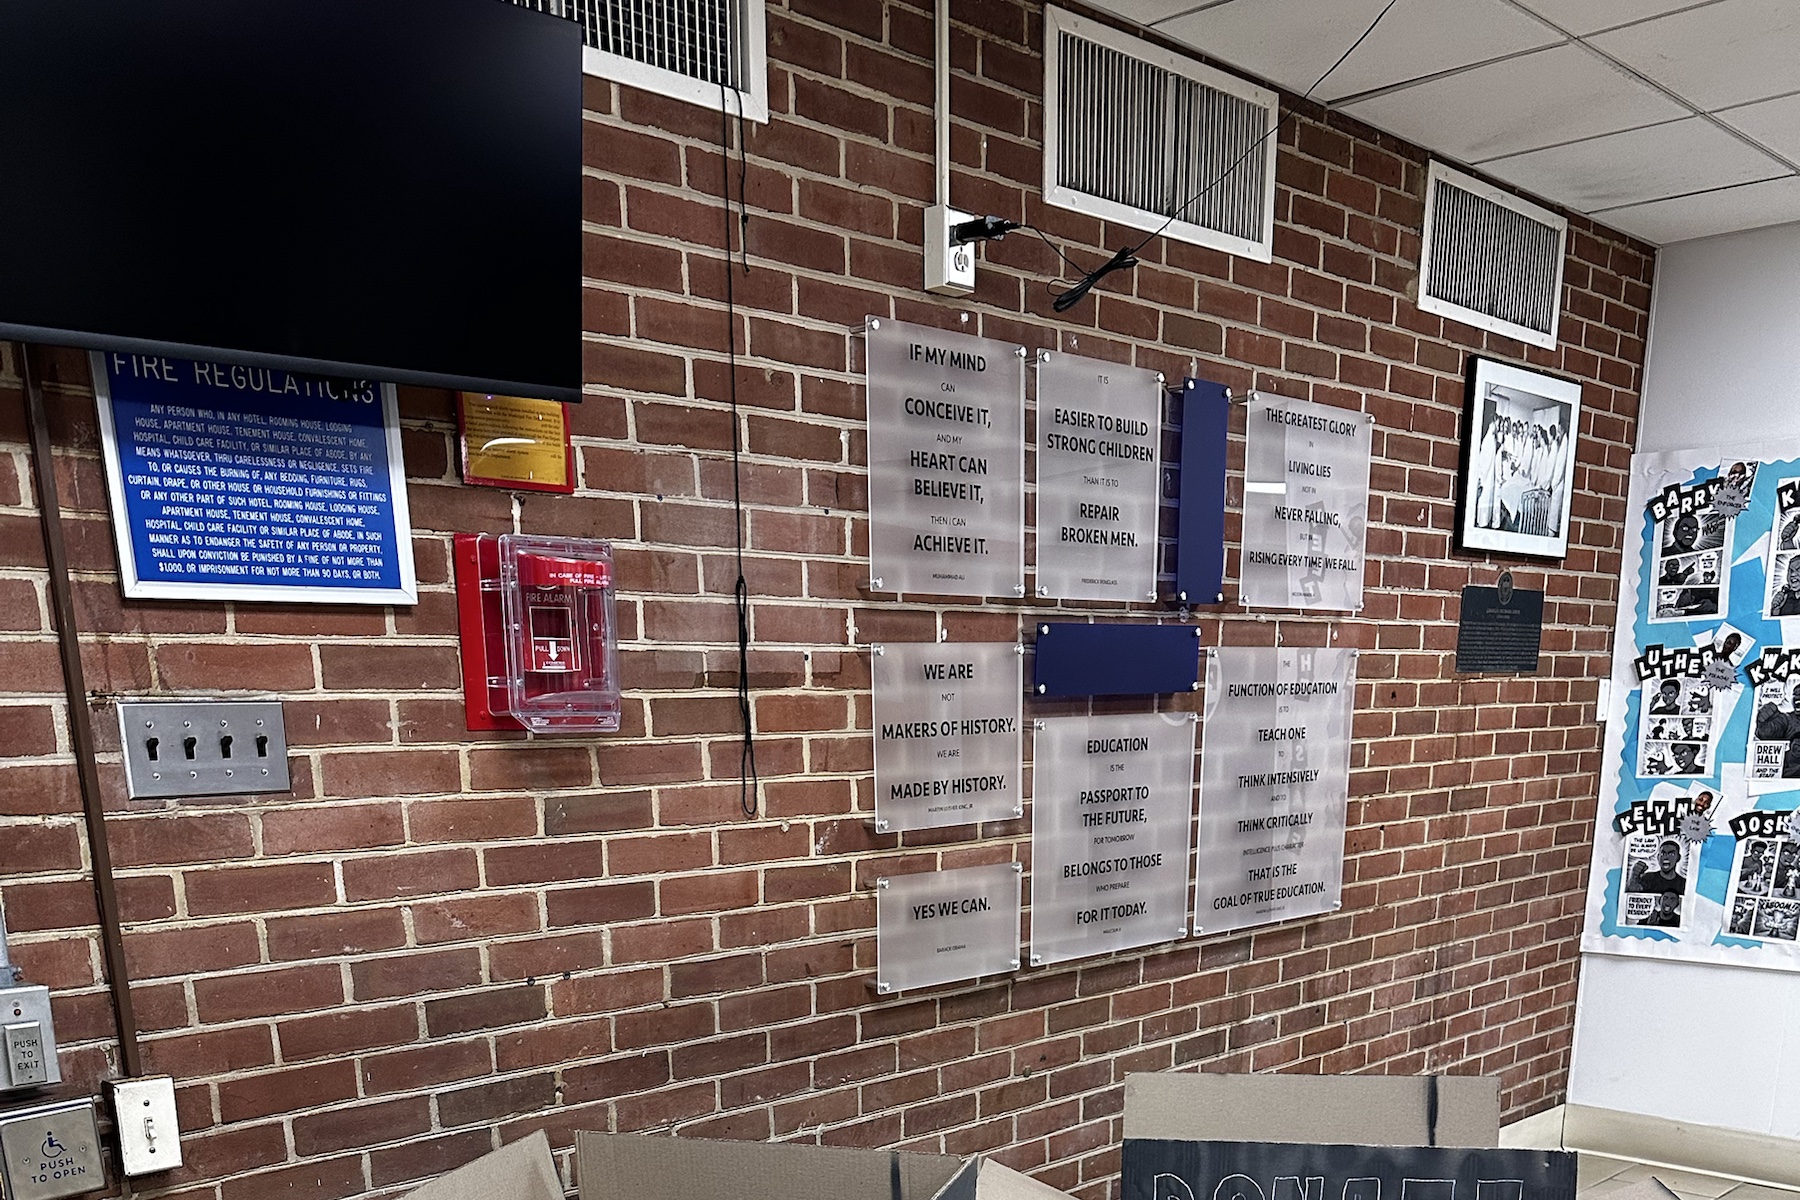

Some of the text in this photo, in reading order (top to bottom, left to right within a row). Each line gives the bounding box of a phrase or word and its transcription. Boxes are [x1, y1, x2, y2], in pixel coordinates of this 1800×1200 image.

[910, 344, 986, 372] IF MY MIND
[114, 353, 178, 382] FIRE
[941, 383, 955, 392] CAN
[1098, 375, 1109, 384] IT IS
[905, 398, 991, 429] CONCEIVE IT,
[1055, 408, 1148, 436] EASIER TO BUILD
[1266, 408, 1356, 436] THE GREATEST GLORY
[936, 434, 962, 444] AND MY
[1048, 433, 1153, 462] STRONG CHILDREN
[910, 450, 987, 474] HEART CAN
[1289, 461, 1331, 478] LIVING LIES
[1083, 476, 1099, 485] THAN
[1112, 479, 1118, 487] TO
[914, 479, 984, 504] BELIEVE IT,
[1652, 484, 1720, 519] BARRY
[162, 506, 203, 517] APARTMENT
[233, 510, 268, 522] TENEMENT
[295, 514, 343, 525] CONVALESCENT
[931, 516, 966, 526] THEN CAN
[1080, 503, 1120, 521] REPAIR
[1275, 506, 1341, 528] NEVER FALLING,
[914, 535, 988, 554] ACHIEVE IT.
[1062, 527, 1138, 547] BROKEN MEN.
[152, 548, 176, 558] SHALL
[178, 549, 196, 559] UPON
[199, 550, 238, 561] CONVICTION
[241, 552, 250, 561] BE
[252, 553, 284, 563] PUNISHED
[286, 554, 295, 563] BY
[305, 555, 319, 564] FINE
[321, 556, 330, 564] OF
[332, 556, 344, 565] NOT
[347, 557, 364, 566] MORE
[367, 558, 383, 566] THAN
[1250, 551, 1357, 571] RISING EVERY TIME WE FALL.
[526, 593, 572, 602] FIRE ALARM
[924, 664, 973, 680] WE ARE
[1639, 650, 1714, 677] LUTHER
[942, 693, 955, 701] NOT
[1229, 682, 1337, 697] FUNCTION OF EDUCATION
[883, 718, 1016, 740] MAKERS OF HISTORY.
[1258, 727, 1306, 741] TEACH ONE
[937, 749, 960, 758] WE ARE
[1087, 737, 1148, 754] EDUCATION
[1757, 746, 1782, 754] DREW
[1757, 756, 1779, 764] HALL
[891, 775, 1006, 799] MADE BY HISTORY.
[1239, 769, 1319, 788] THINK INTENSIVELY
[1080, 786, 1149, 804] PASSPORT TO
[1083, 809, 1147, 827] THE FUTURE,
[1238, 812, 1313, 832] THINK CRITICALLY
[1620, 803, 1688, 832] KEVIN
[1737, 816, 1789, 836] JOSH
[1105, 834, 1135, 843] TOMORROW
[1064, 854, 1162, 878] BELONGS TO THOSE
[1249, 863, 1297, 881] THAT IS THE
[1096, 881, 1129, 892] WHO PREPARE
[1214, 895, 1238, 910] GOAL
[1240, 893, 1252, 906] OF
[1254, 889, 1275, 903] TRUE
[1277, 882, 1326, 900] EDUCATION.
[913, 897, 990, 920] YES WE CAN.
[1077, 902, 1147, 924] FOR IT TODAY.
[14, 1039, 38, 1049] PUSH
[18, 1061, 39, 1070] EXIT
[41, 1157, 74, 1171] PUSH
[32, 1166, 86, 1184] TO OPEN
